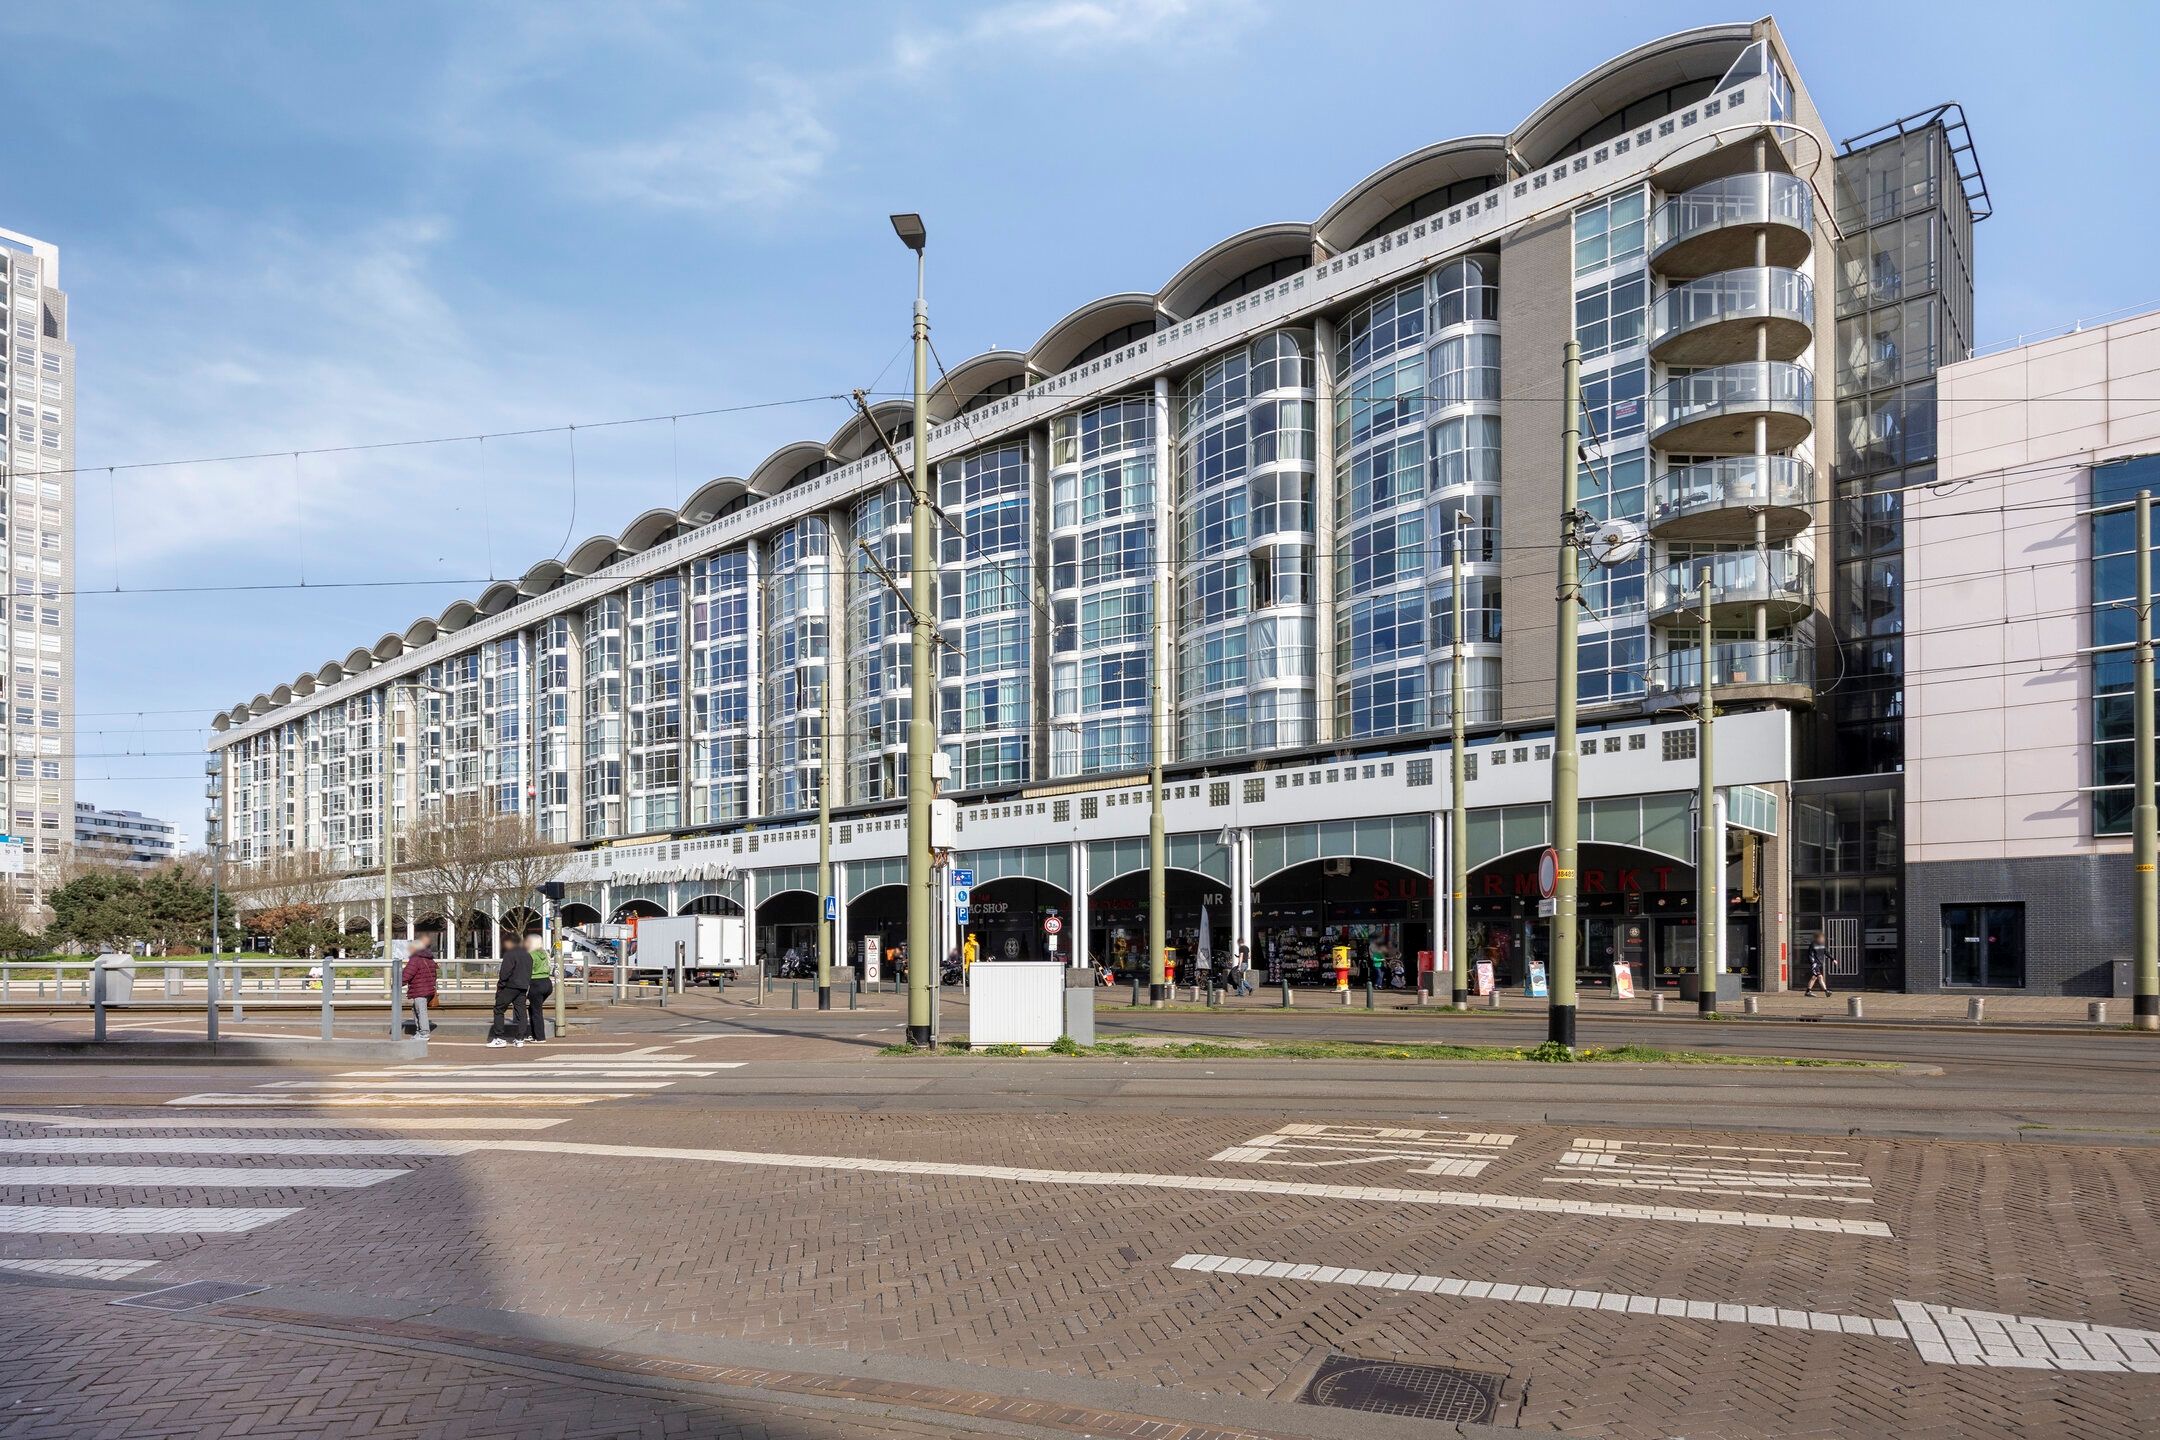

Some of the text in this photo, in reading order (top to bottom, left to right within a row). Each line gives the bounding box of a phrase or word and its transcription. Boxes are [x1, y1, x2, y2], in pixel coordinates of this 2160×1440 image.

[1374, 866, 1674, 899] SURMRKT
[982, 902, 1008, 913] SHOP
[1203, 893, 1224, 905] MR
[1208, 1123, 1518, 1178] BUS
